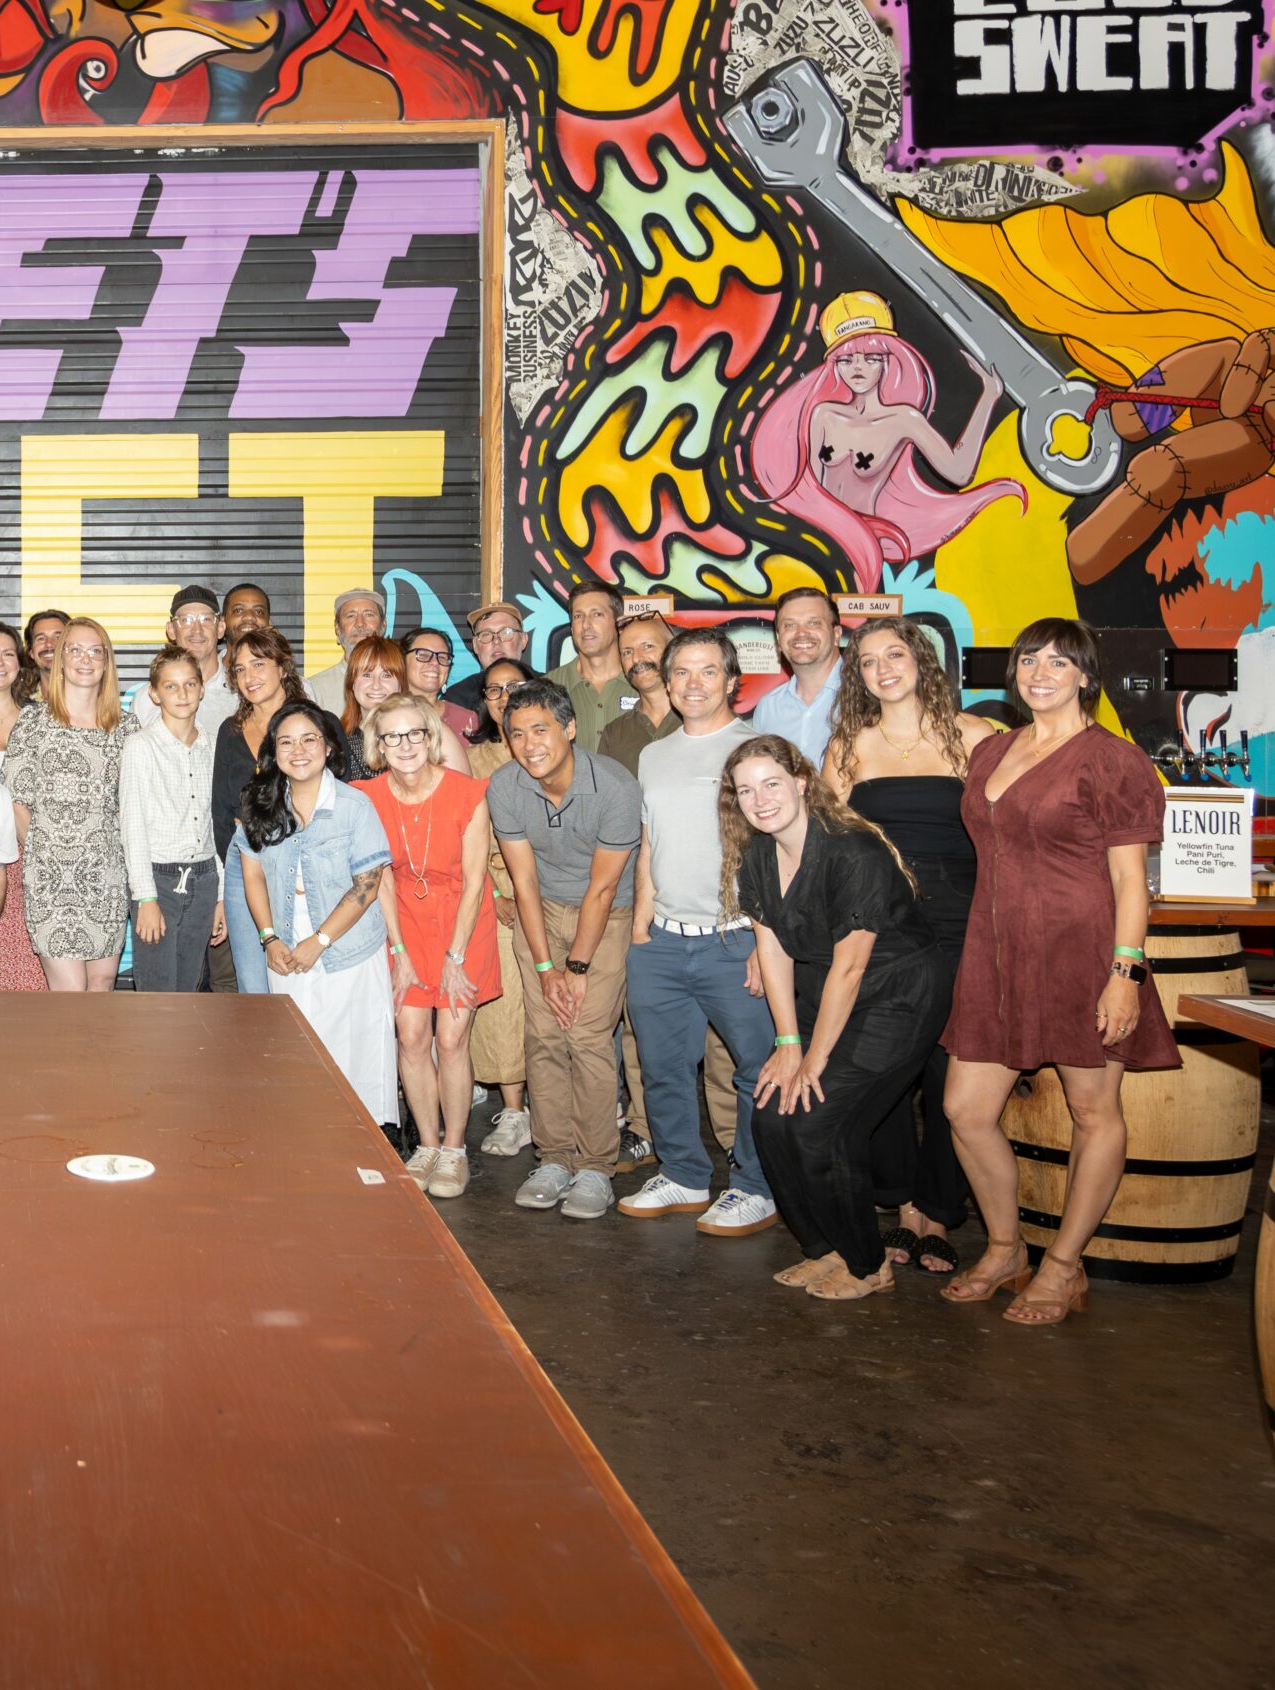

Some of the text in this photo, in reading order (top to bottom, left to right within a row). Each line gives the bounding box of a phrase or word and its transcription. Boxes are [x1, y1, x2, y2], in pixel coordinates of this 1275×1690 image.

[773, 14, 810, 56] ZUZU
[954, 11, 1251, 96] SWEAT
[506, 312, 522, 384] MONKEY
[628, 603, 651, 612] ROSE
[848, 602, 891, 610] CAB SAUV
[1171, 809, 1243, 836] LENOIR
[1177, 842, 1235, 851] Yellowfin Tuna
[1206, 851, 1225, 860] Puri,
[1175, 858, 1237, 868] Leche de Tigre,
[1196, 867, 1215, 875] Chili
